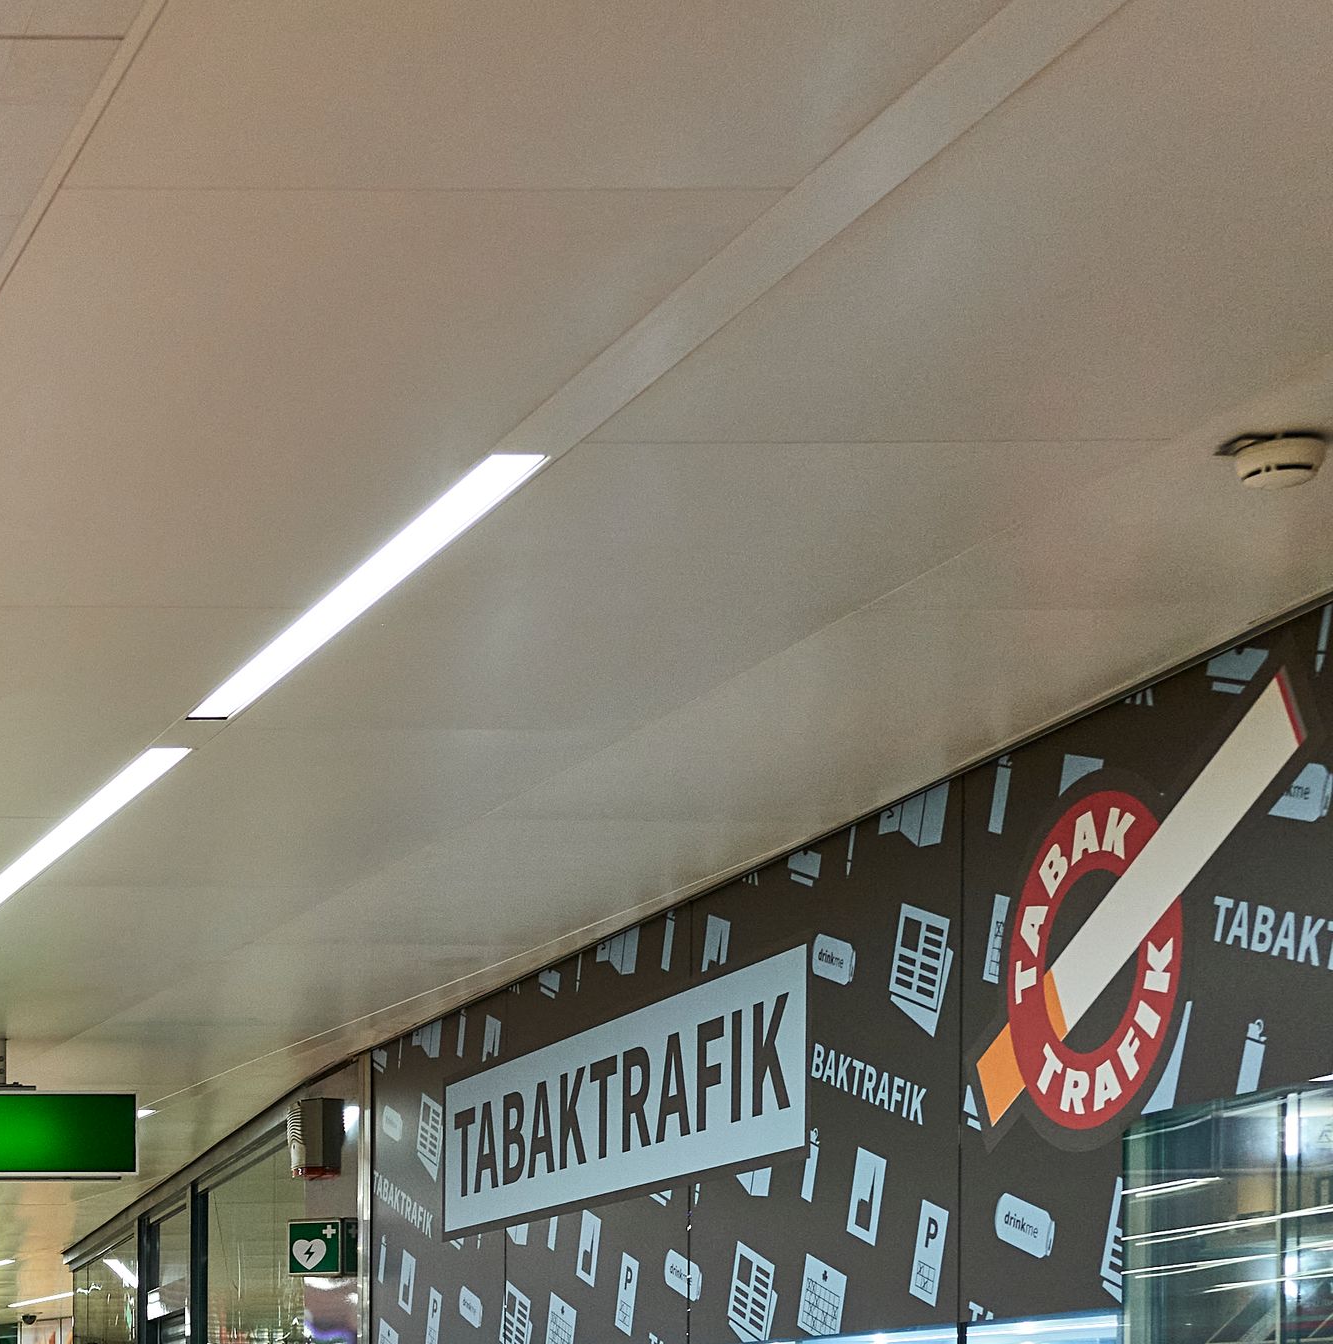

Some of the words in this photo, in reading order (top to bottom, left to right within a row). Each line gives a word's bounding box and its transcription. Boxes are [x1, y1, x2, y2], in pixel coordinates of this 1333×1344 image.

[1015, 807, 1136, 1004] TABAK
[453, 992, 791, 1198] TABAKTRAFIK
[1035, 937, 1174, 1115] TRAFIK
[373, 1170, 434, 1239] TABAKTRAFIK
[1004, 1211, 1038, 1239] drinkme
